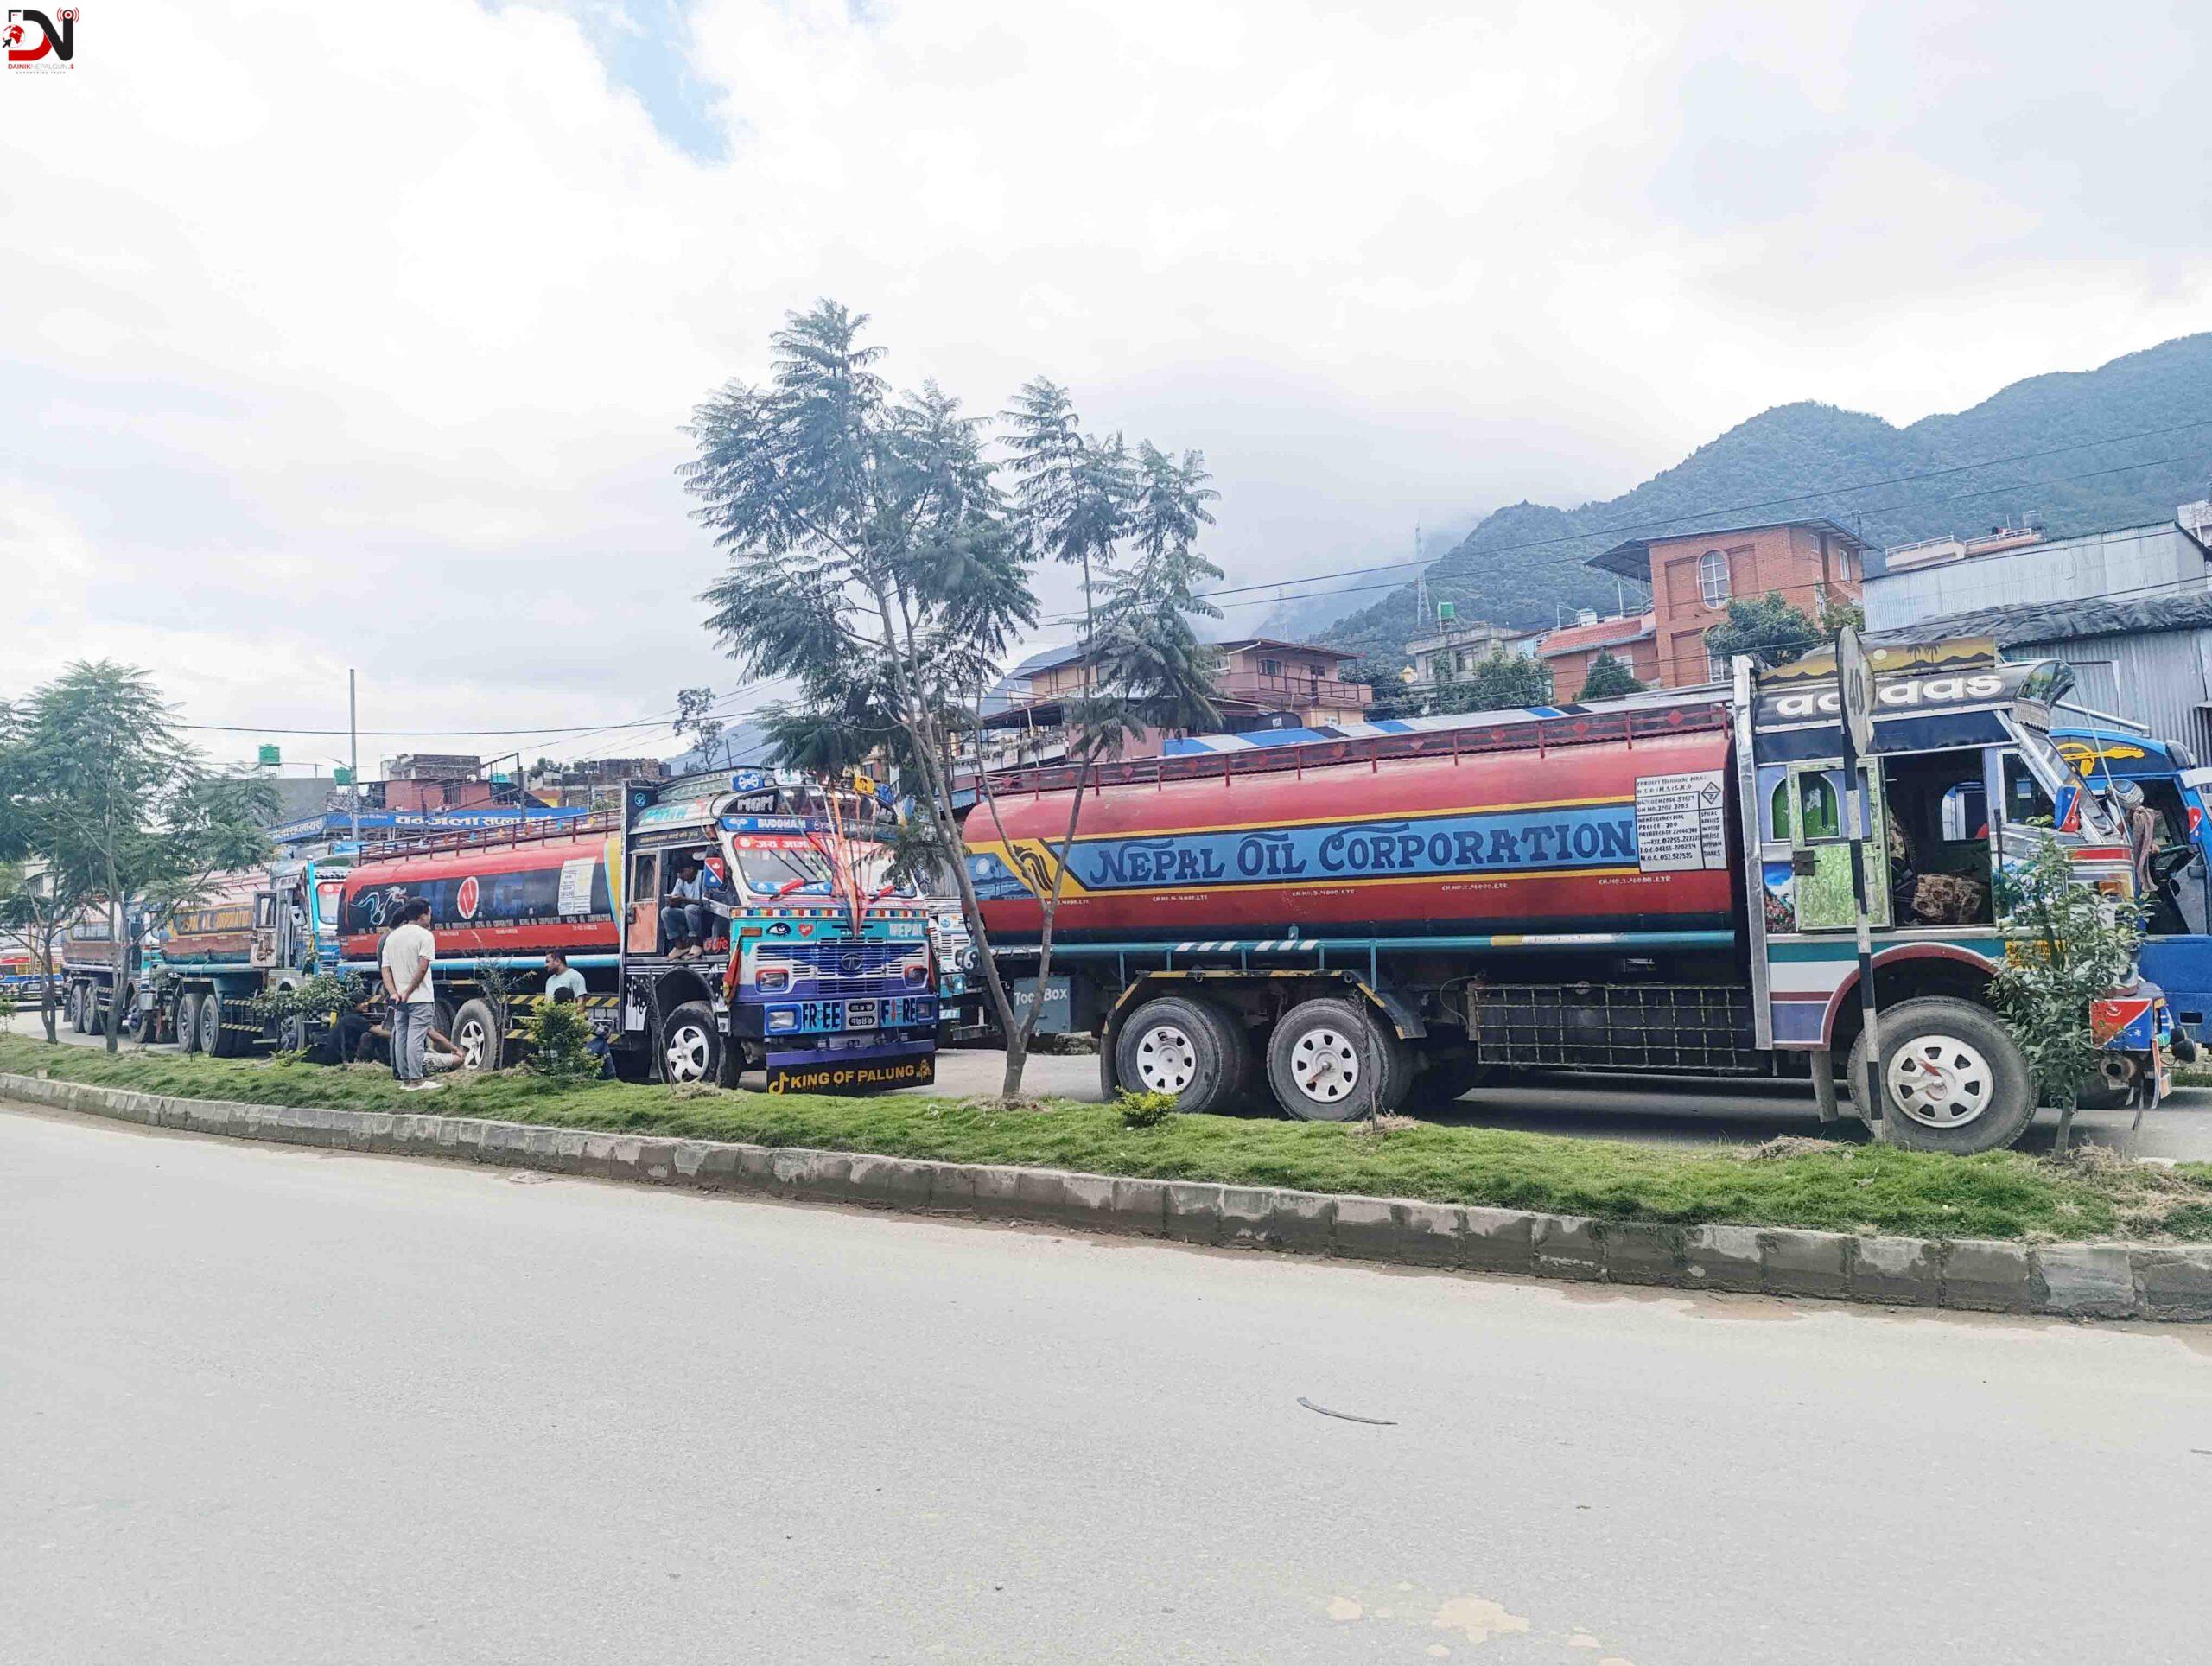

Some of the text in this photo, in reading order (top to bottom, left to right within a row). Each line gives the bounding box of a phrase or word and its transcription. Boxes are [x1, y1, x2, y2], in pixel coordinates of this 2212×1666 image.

[1089, 821, 1636, 885] NEPAL OIL CORPORATION
[888, 923, 923, 937] NEPAL
[802, 1002, 842, 1030] FREE
[791, 1071, 830, 1089] KING
[833, 1070, 851, 1085] OF
[857, 1065, 915, 1082] PALUNG
